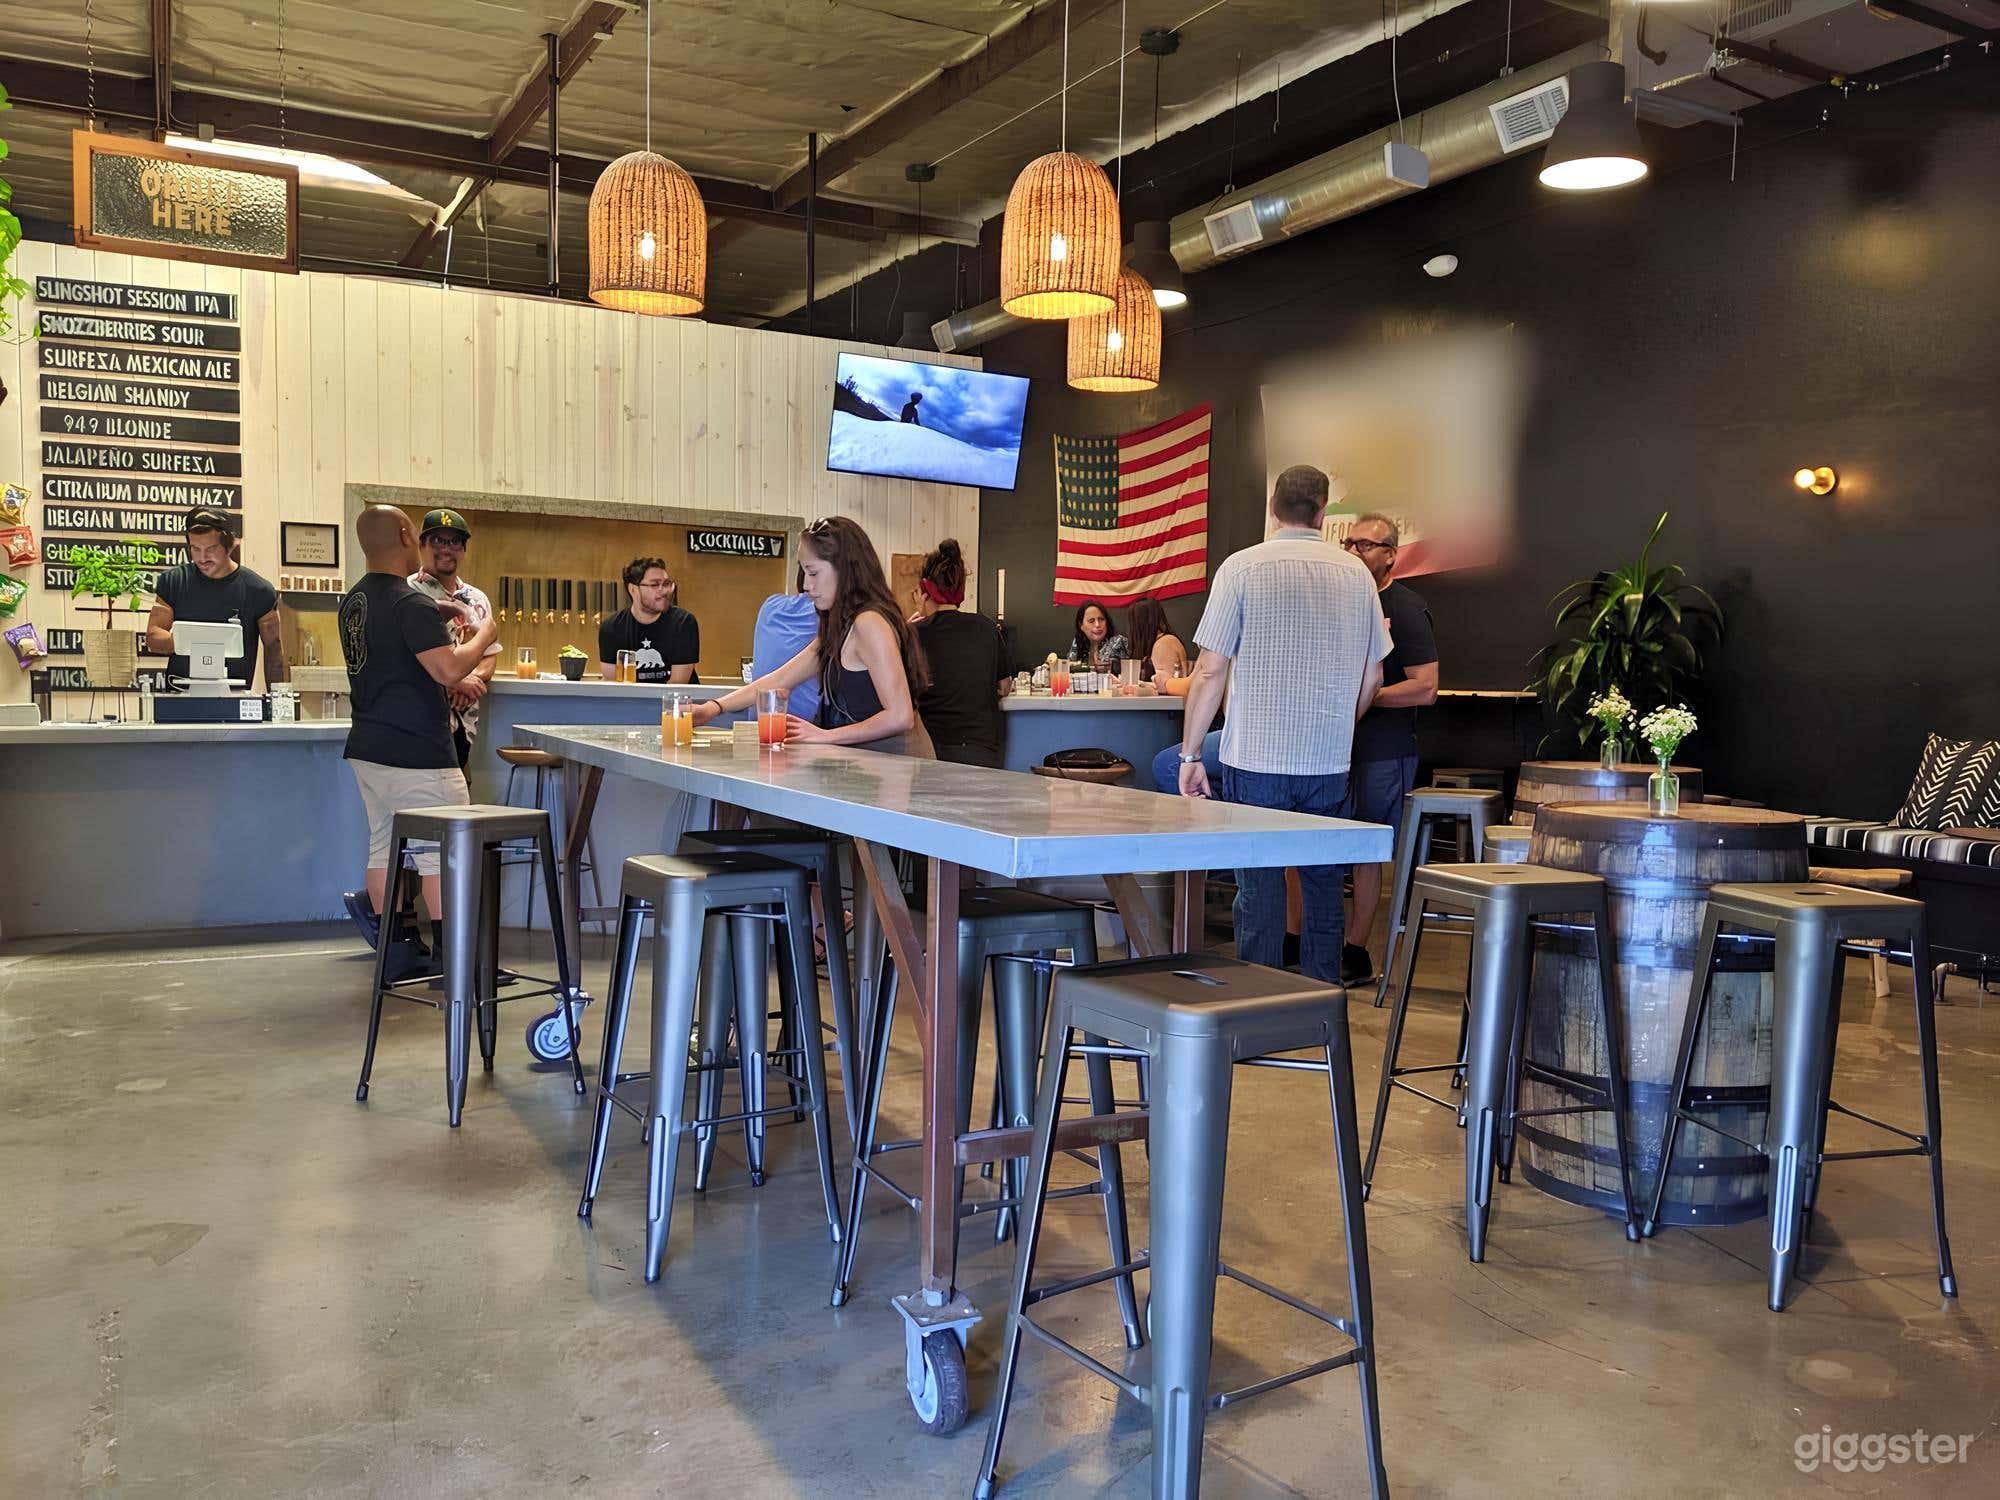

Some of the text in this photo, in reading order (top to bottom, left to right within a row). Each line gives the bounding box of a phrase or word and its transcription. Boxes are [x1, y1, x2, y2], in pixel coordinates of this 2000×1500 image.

[152, 196, 233, 236] HERE
[38, 280, 220, 314] SLINGSHOT SESSION IPA
[161, 325, 205, 346] SOUR
[126, 353, 201, 377] MEXICAN
[205, 360, 232, 379] ALE
[47, 380, 190, 408] BELGIAN SHANDY
[106, 417, 172, 440] BLONDE
[45, 479, 93, 500] CITRA
[137, 484, 187, 505] DOWN
[190, 487, 235, 507] HAZY
[47, 508, 114, 529] BELGIAN
[699, 532, 765, 551] COCKTAILS
[50, 631, 70, 650] LIL
